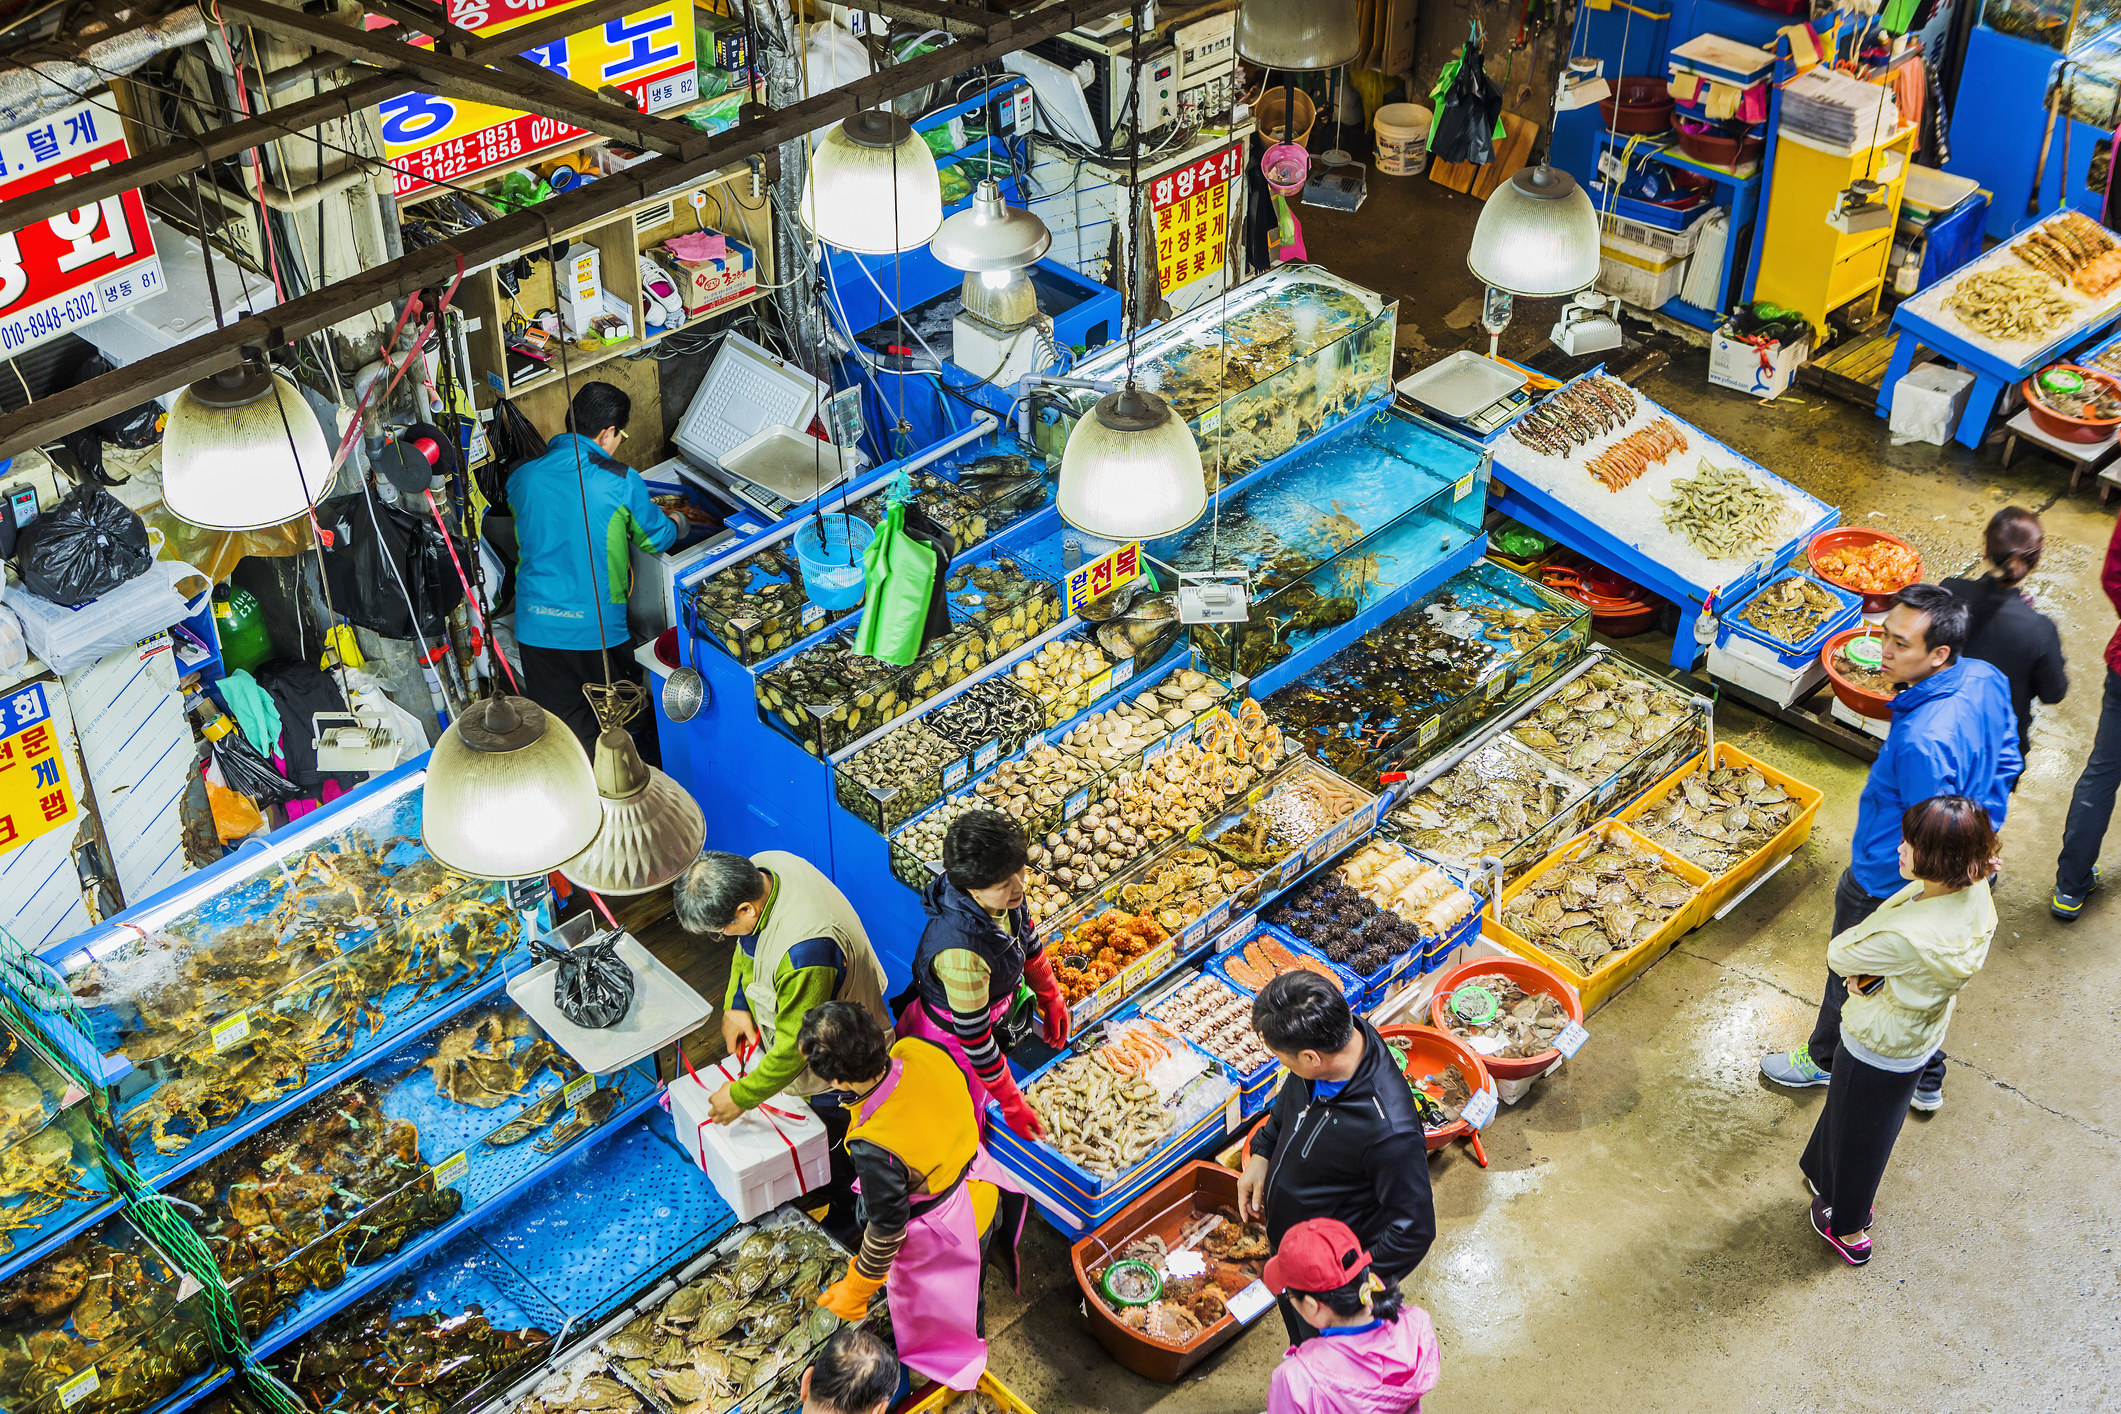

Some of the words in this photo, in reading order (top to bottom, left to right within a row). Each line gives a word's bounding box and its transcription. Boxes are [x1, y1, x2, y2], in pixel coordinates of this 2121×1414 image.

[652, 84, 673, 103] 냉동
[680, 78, 693, 94] 82
[1155, 149, 1238, 207] 화양수산
[104, 280, 133, 303] 냉동
[141, 271, 158, 289] 81
[1, 291, 98, 350] 010-8948-6302
[1091, 545, 1137, 596] 전복
[72, 663, 96, 689] STAINLESS
[85, 707, 108, 734] STAINLESS
[97, 751, 119, 778] STAINLESS
[108, 793, 130, 819] STAINLESS
[120, 834, 142, 860] STAINLESS
[130, 875, 153, 900] STAINLESS
